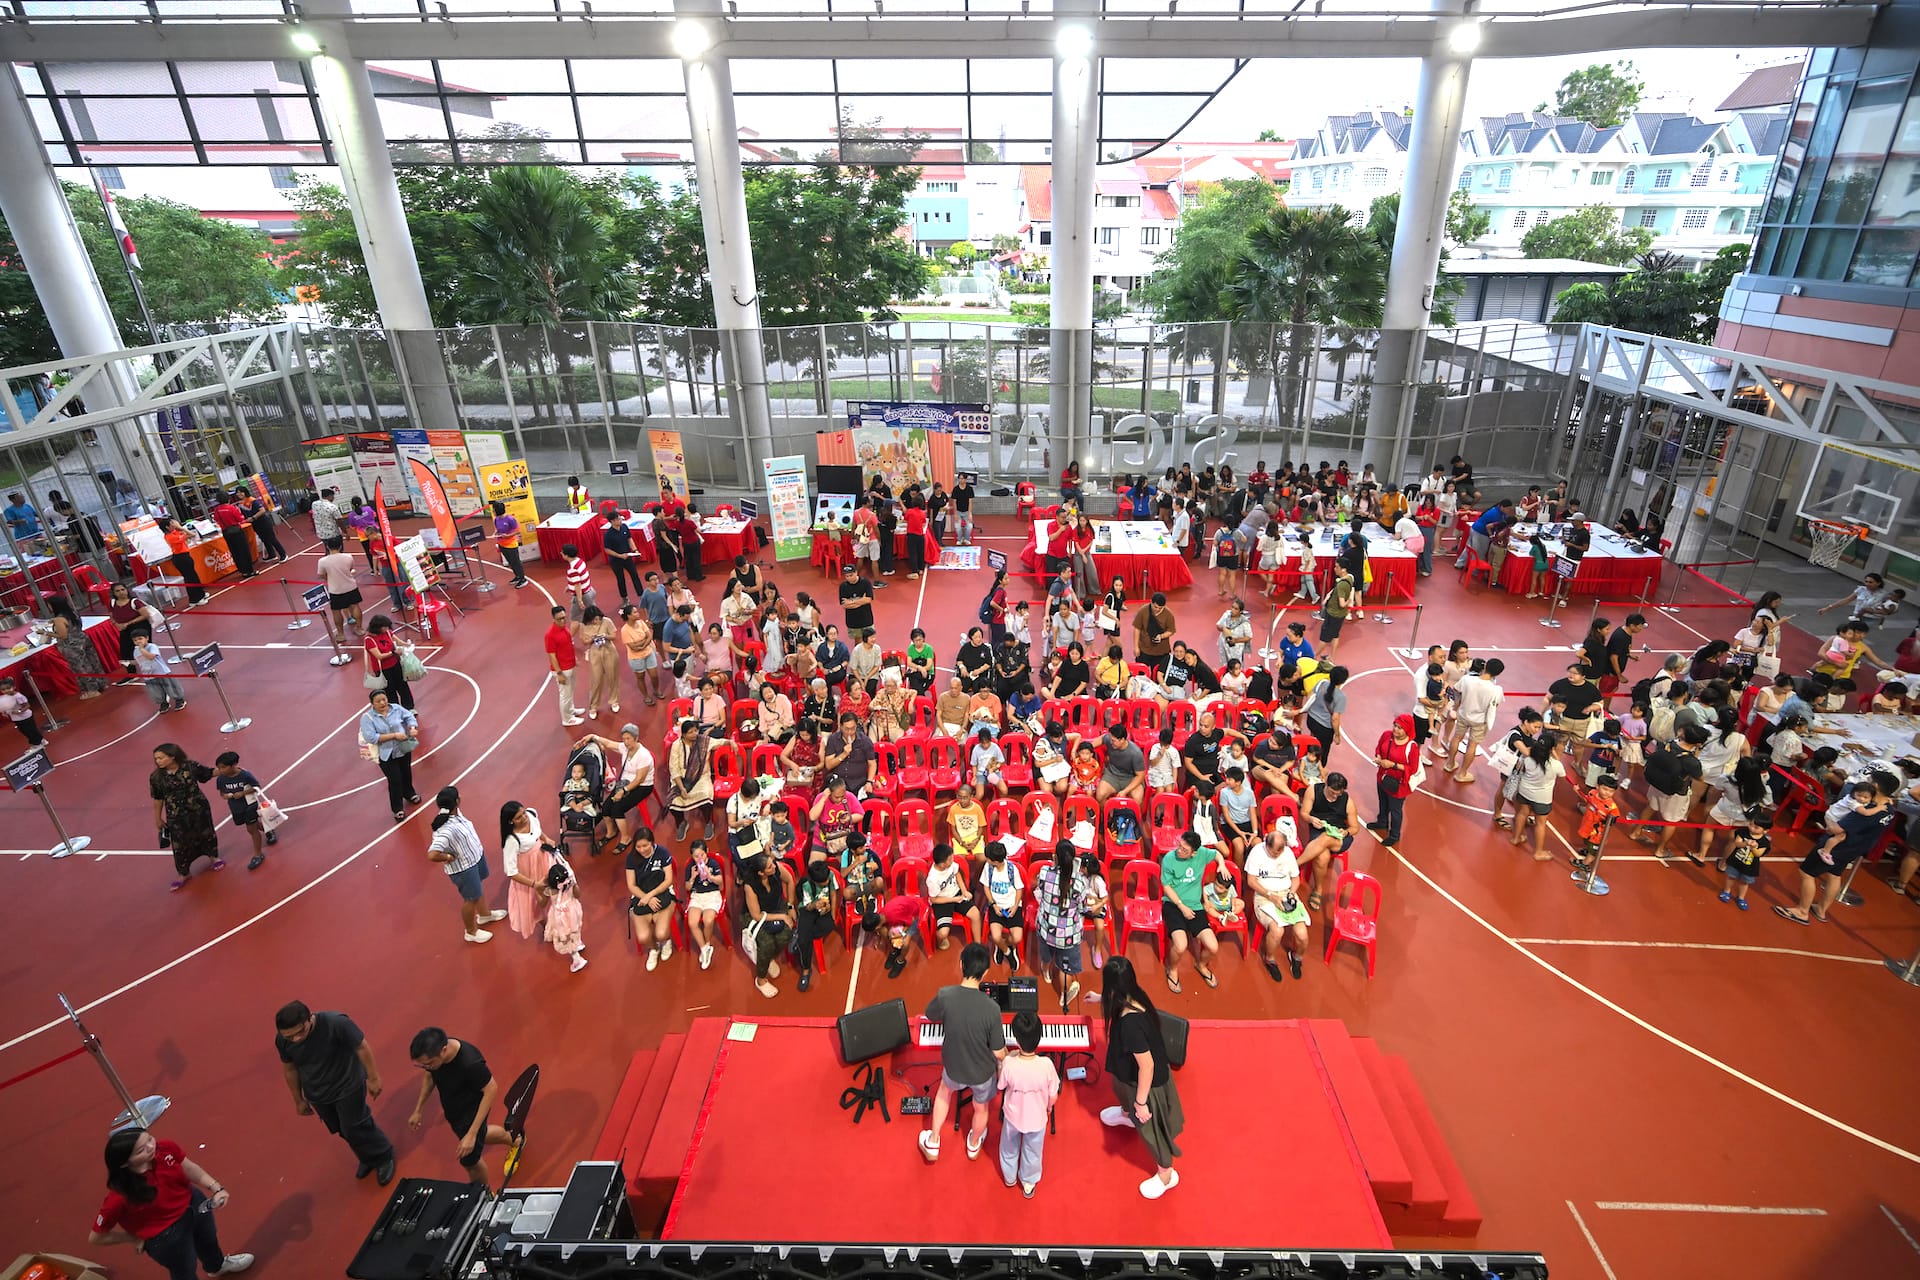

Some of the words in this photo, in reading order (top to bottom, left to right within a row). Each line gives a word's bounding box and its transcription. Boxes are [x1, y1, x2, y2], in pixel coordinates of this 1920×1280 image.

[885, 409, 908, 421] BEDOK
[909, 408, 937, 416] FAMILY
[937, 411, 953, 422] DAY
[489, 487, 503, 496] JOIN
